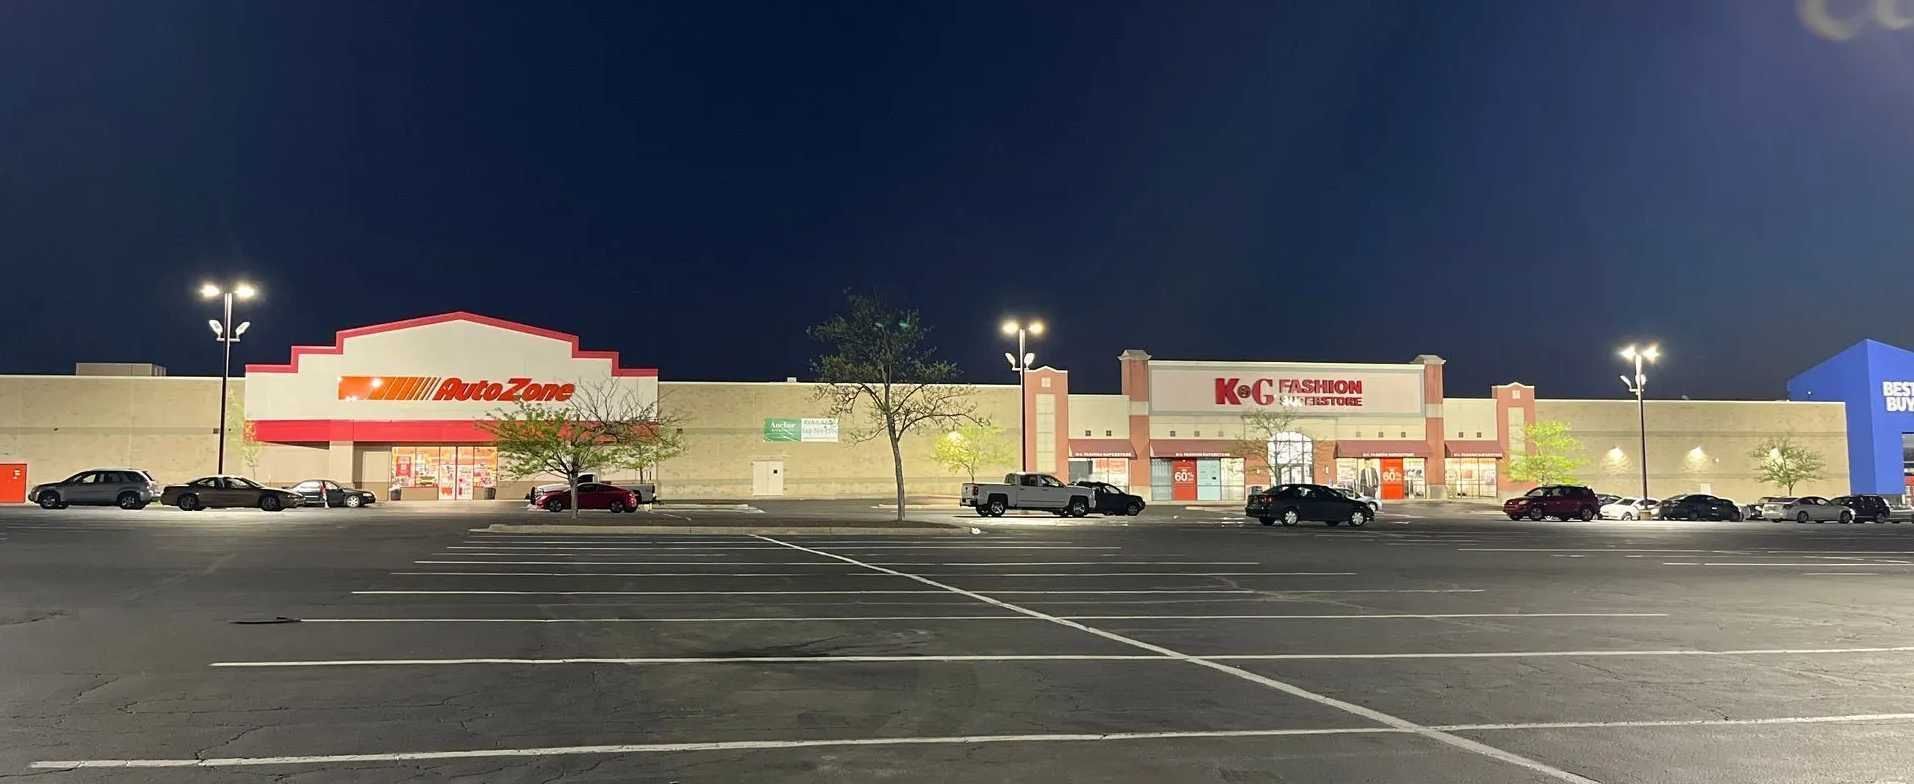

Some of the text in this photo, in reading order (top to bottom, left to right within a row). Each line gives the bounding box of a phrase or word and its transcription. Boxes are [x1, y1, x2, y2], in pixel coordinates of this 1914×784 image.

[432, 377, 576, 401] AutoZone
[1279, 379, 1363, 394] FASHION
[1279, 396, 1363, 407] ERSTORE
